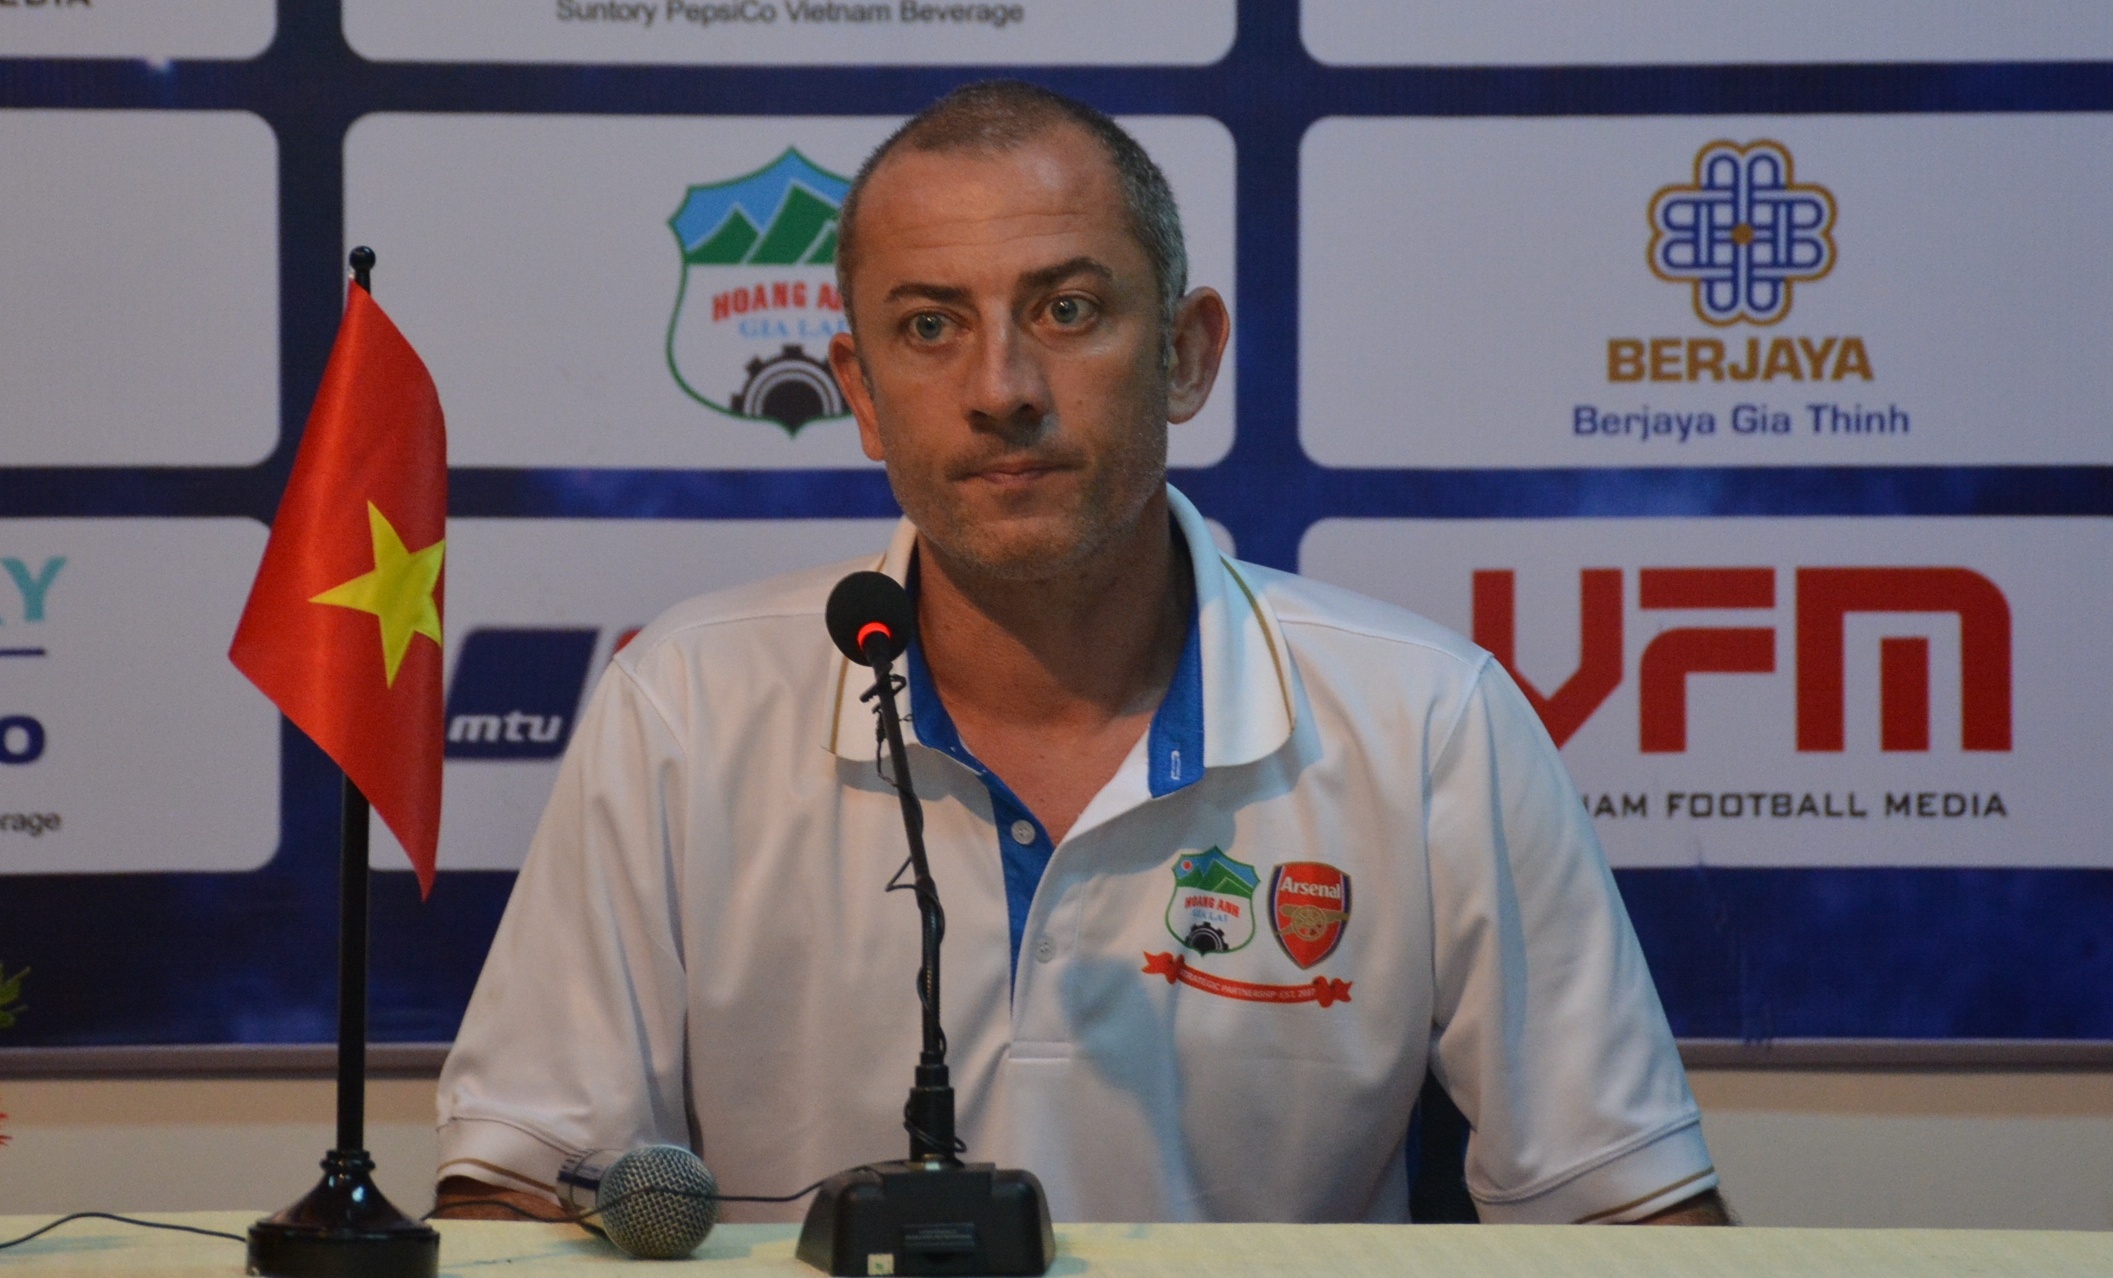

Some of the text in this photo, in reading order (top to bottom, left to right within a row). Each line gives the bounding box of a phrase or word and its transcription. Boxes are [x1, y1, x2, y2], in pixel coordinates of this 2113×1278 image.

[556, 0, 1024, 27] Suntory PepsiCo Vietnam Beverage
[712, 281, 807, 321] HOANG
[1606, 337, 1874, 382] BERJAYA
[1573, 404, 1911, 442] Berjaya Gia Thinh
[0, 555, 67, 623] Y
[1472, 566, 2012, 753] VFM
[449, 711, 563, 743] mtu
[1667, 793, 1867, 818] FOOTBALL
[1885, 793, 2008, 817] MEDIA
[1280, 876, 1341, 899] Arsenal
